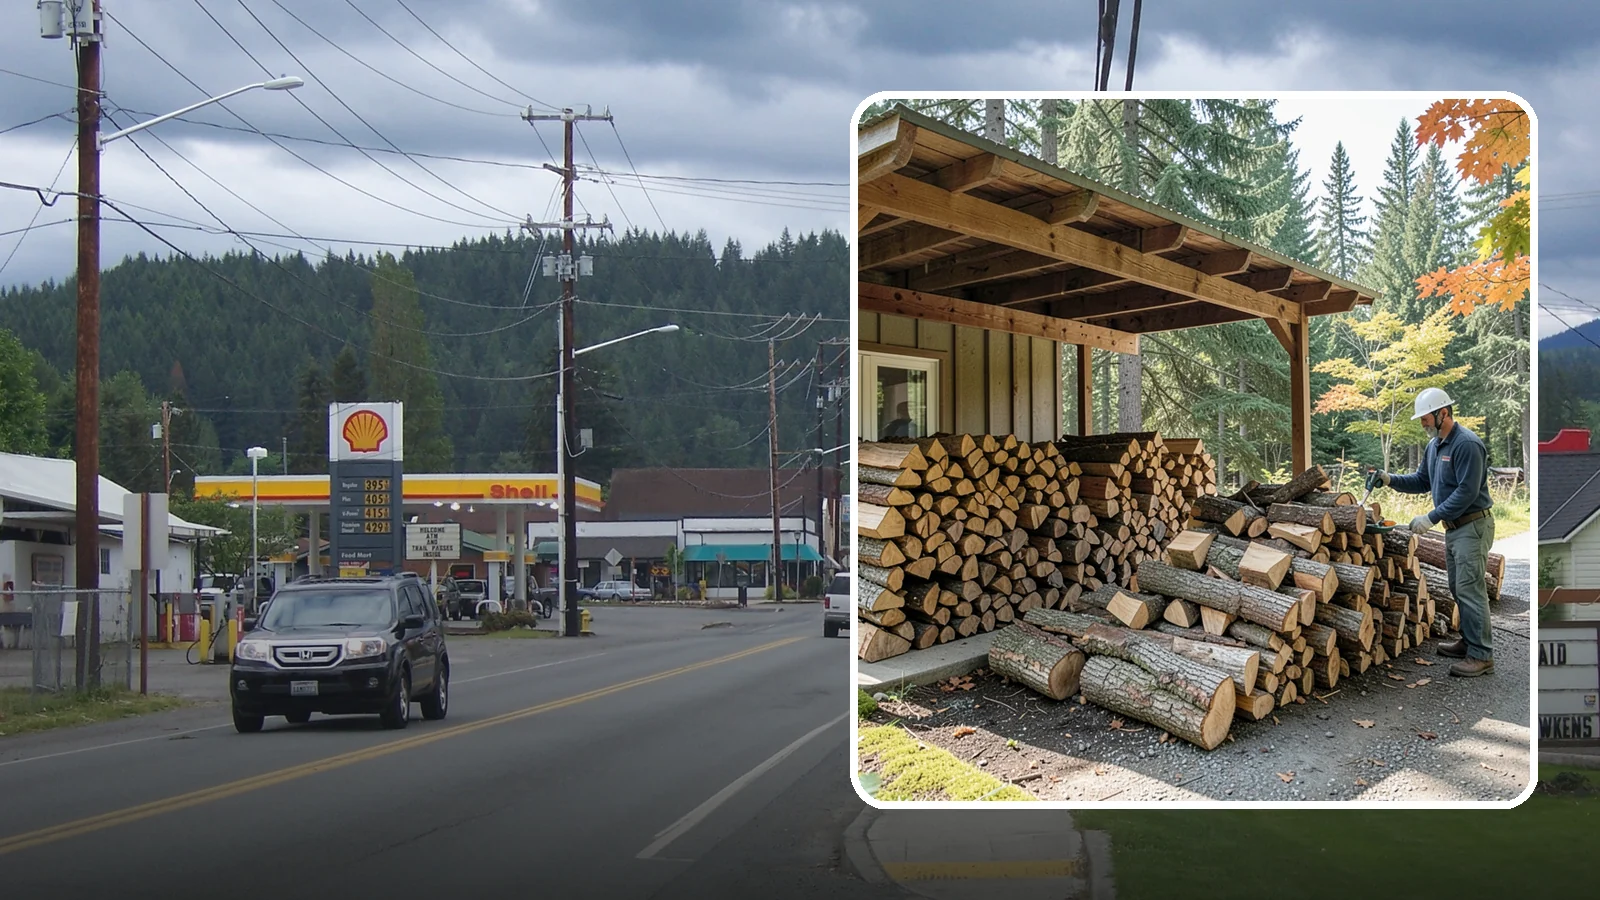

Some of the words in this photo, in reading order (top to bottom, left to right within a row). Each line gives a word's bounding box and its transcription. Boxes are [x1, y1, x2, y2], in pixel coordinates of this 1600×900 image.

[366, 480, 384, 490] 395
[490, 484, 547, 499] Shell
[366, 494, 384, 504] 405
[366, 508, 384, 518] 415
[366, 522, 384, 532] 429
